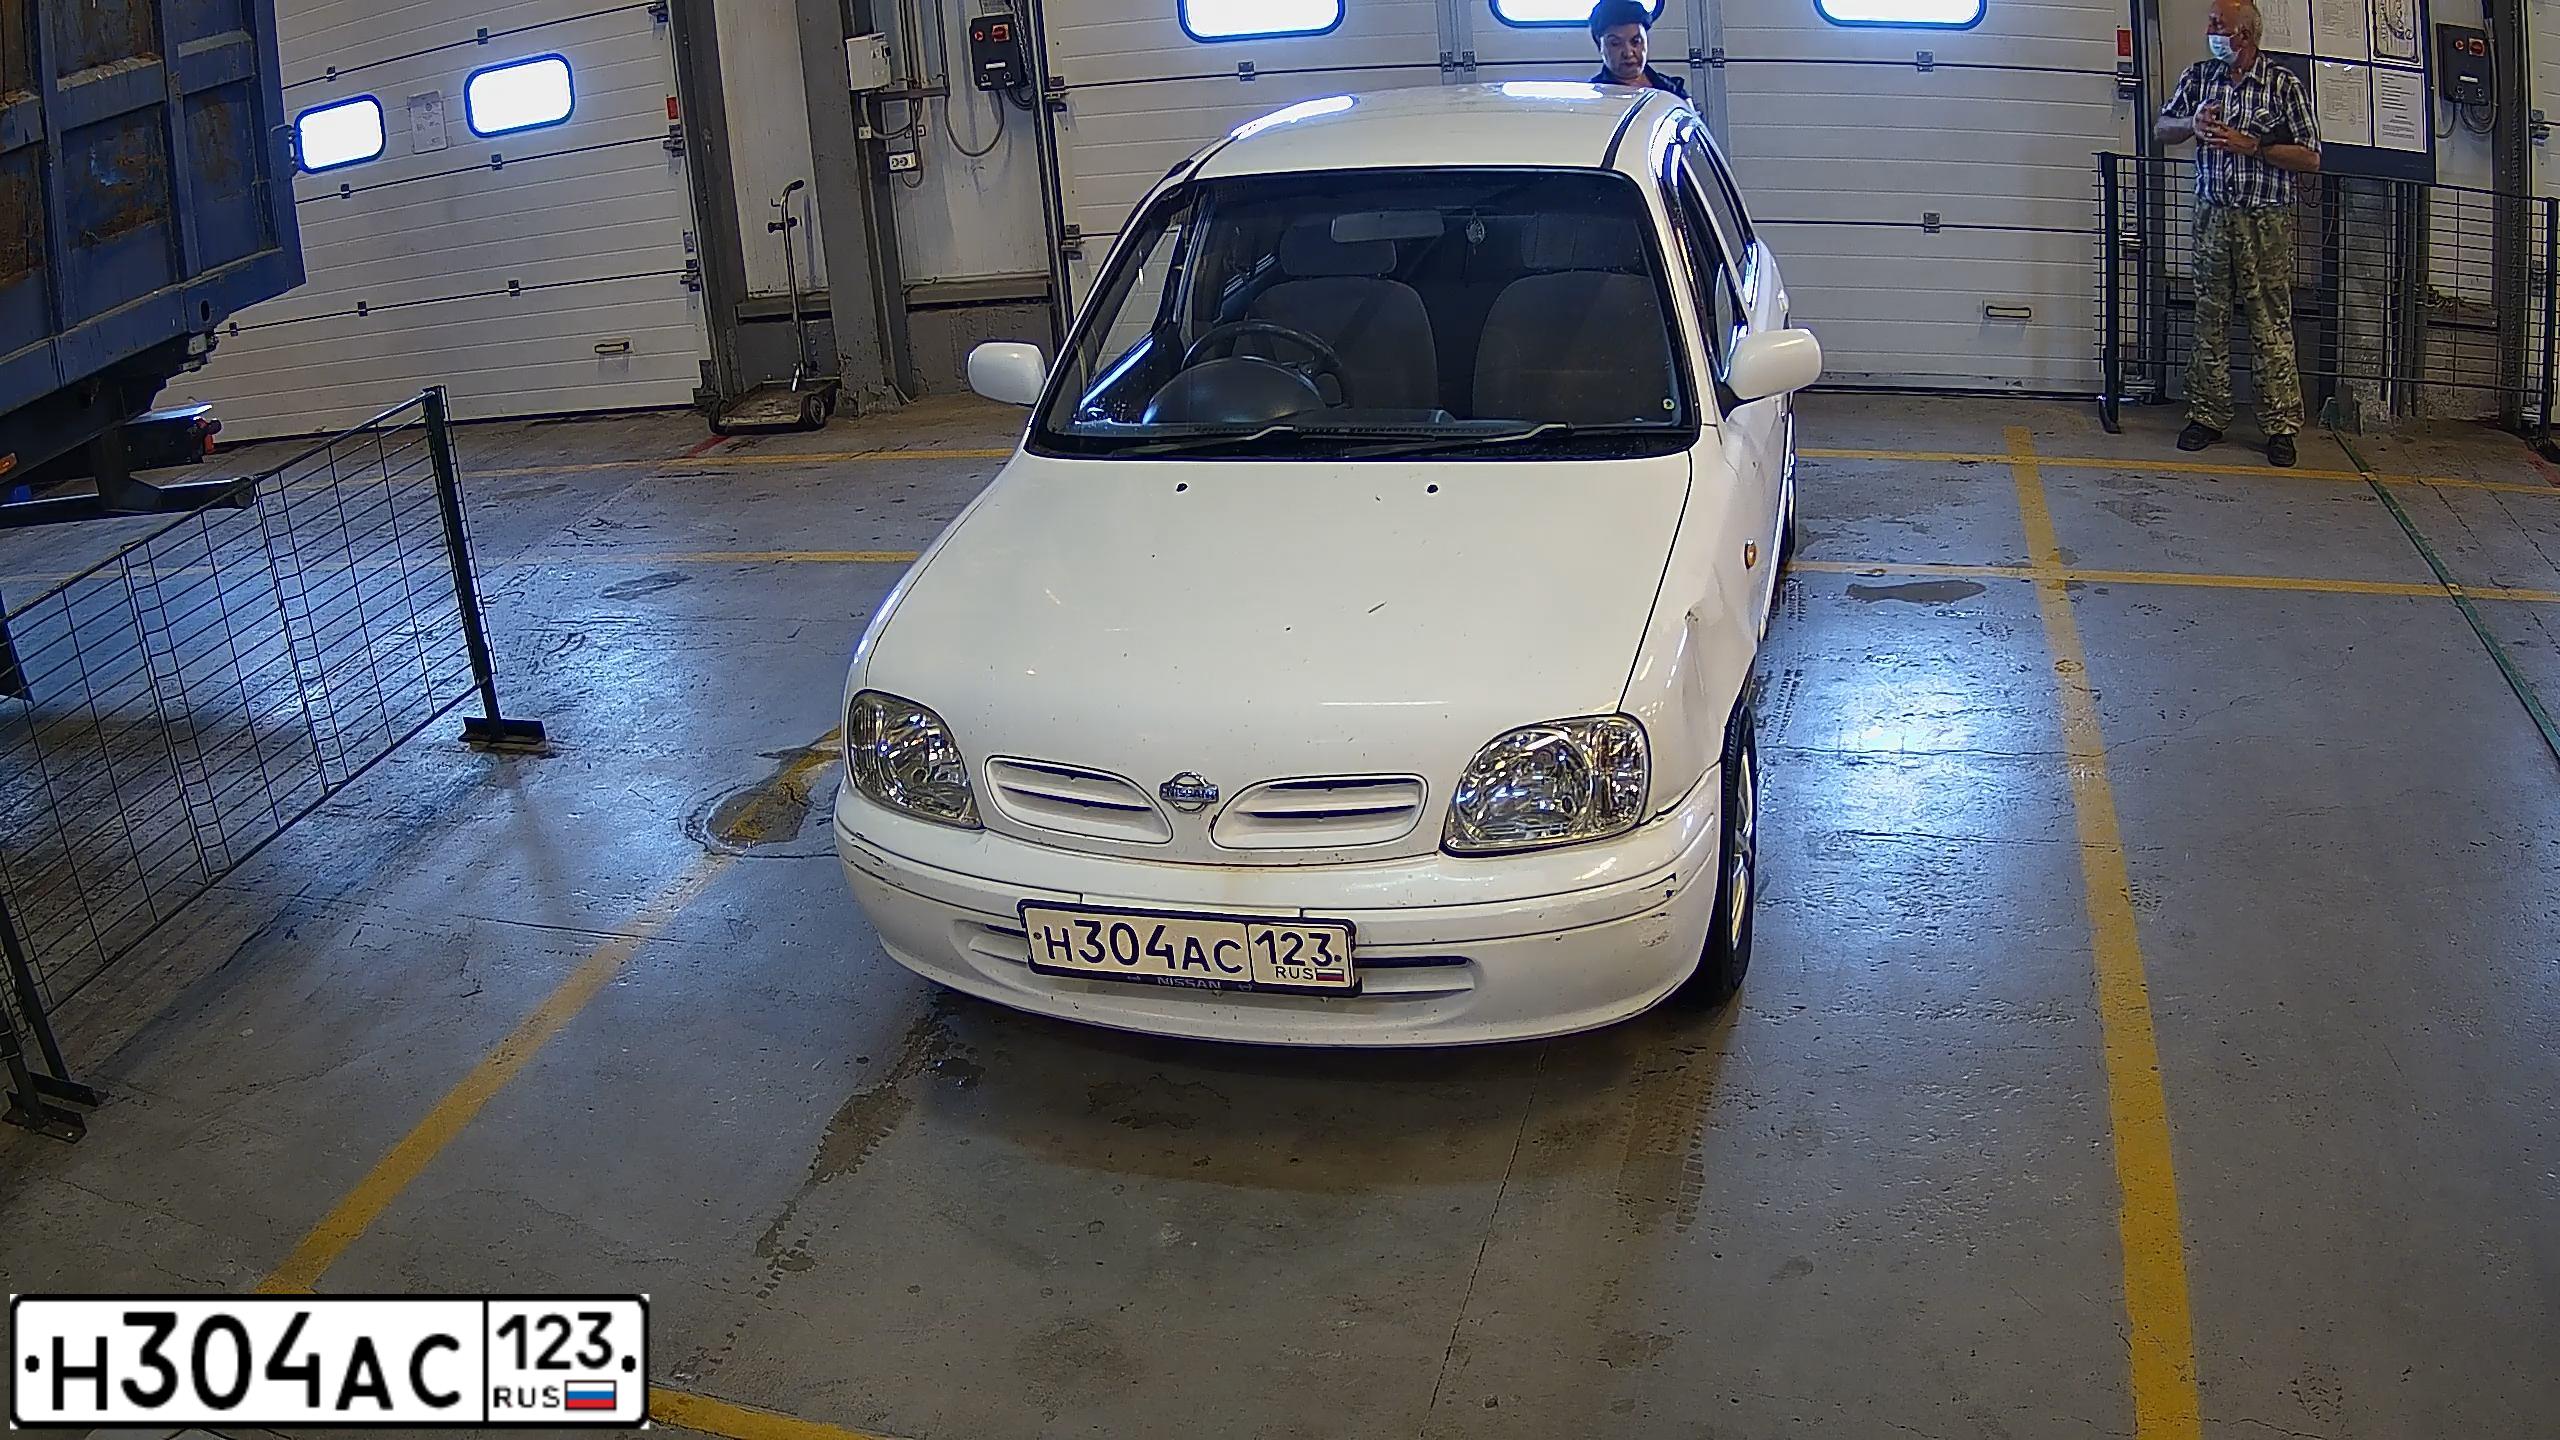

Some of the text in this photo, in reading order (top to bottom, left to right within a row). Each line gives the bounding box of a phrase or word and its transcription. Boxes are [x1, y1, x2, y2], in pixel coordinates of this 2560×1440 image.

[1254, 929, 1333, 968] 123
[1275, 965, 1314, 981] RUS
[1156, 975, 1221, 990] NISSAN
